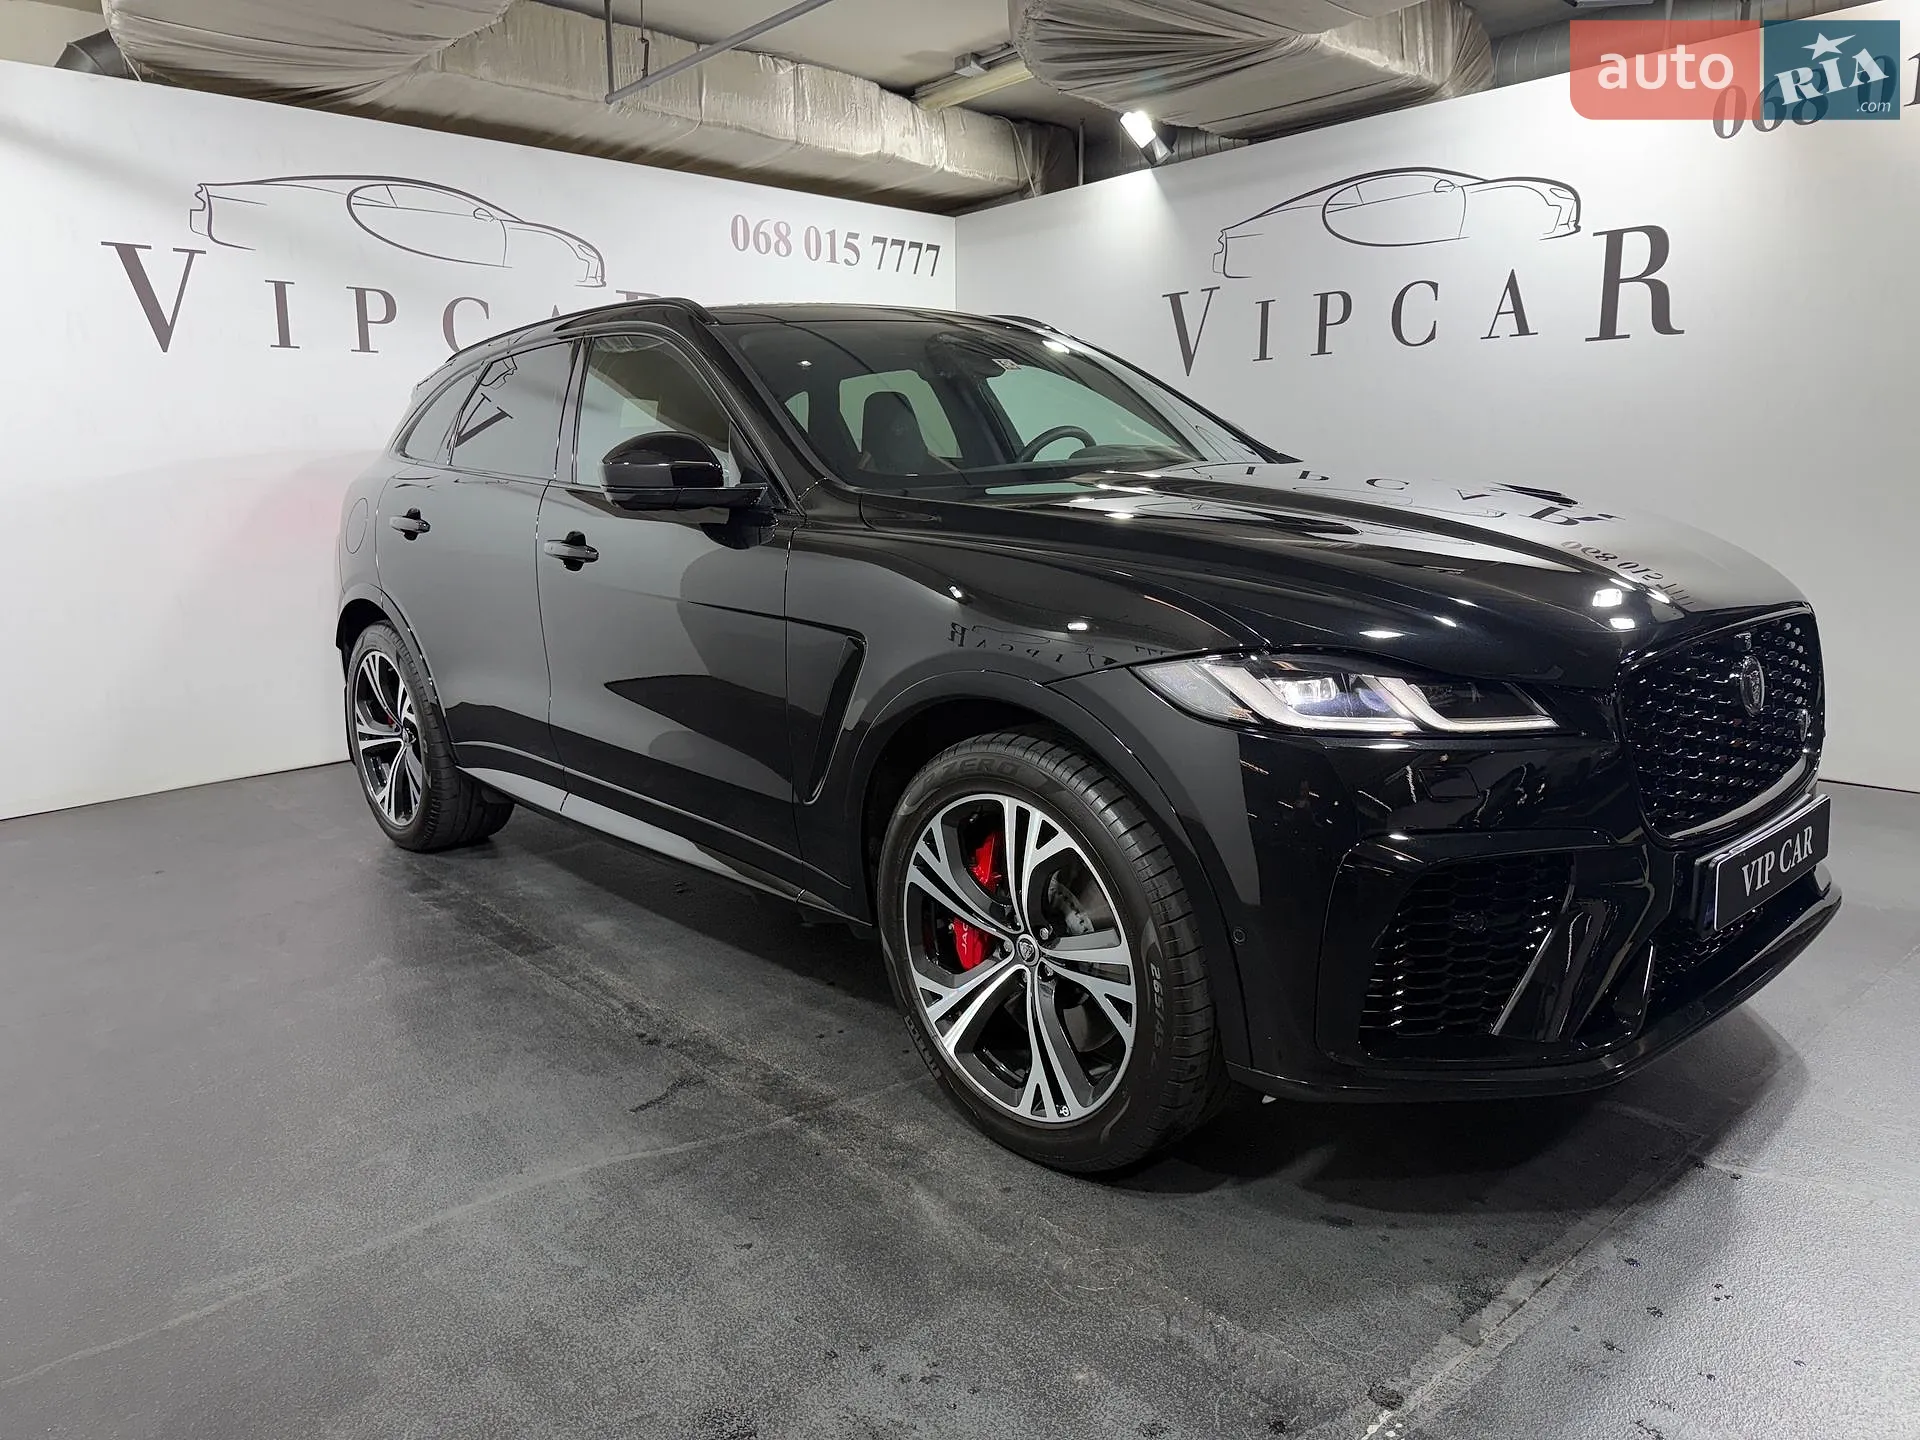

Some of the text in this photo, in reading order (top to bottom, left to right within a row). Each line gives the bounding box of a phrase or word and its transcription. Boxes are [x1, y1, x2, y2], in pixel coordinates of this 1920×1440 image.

[730, 214, 941, 277] 068 015 7777
[1741, 825, 1813, 897] VIP CAR
